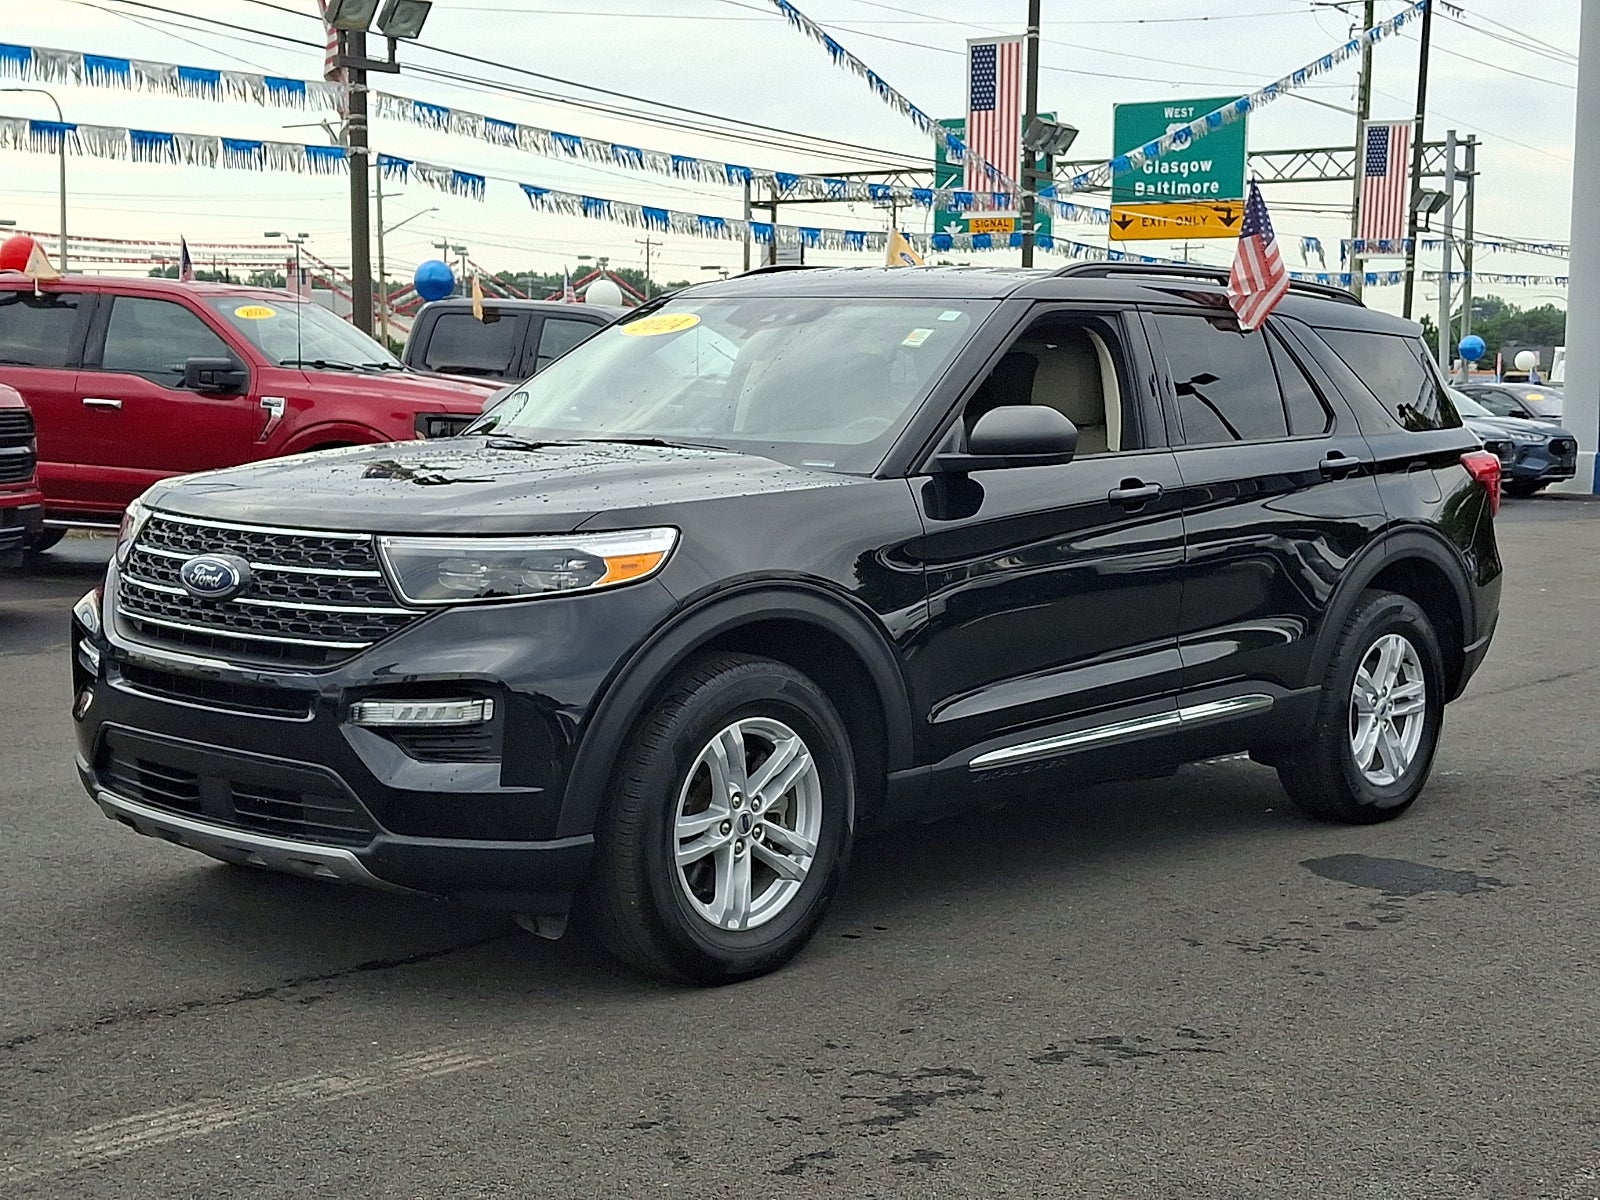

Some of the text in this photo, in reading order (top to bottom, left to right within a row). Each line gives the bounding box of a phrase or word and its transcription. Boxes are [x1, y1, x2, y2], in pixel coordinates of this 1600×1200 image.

[1164, 107, 1195, 118] WEST
[1143, 160, 1213, 178] Glasgow
[1134, 181, 1220, 196] Baltimore
[975, 219, 1009, 228] SIGNAL
[1141, 215, 1209, 227] EXIT ONLY
[190, 564, 223, 588] Ford
